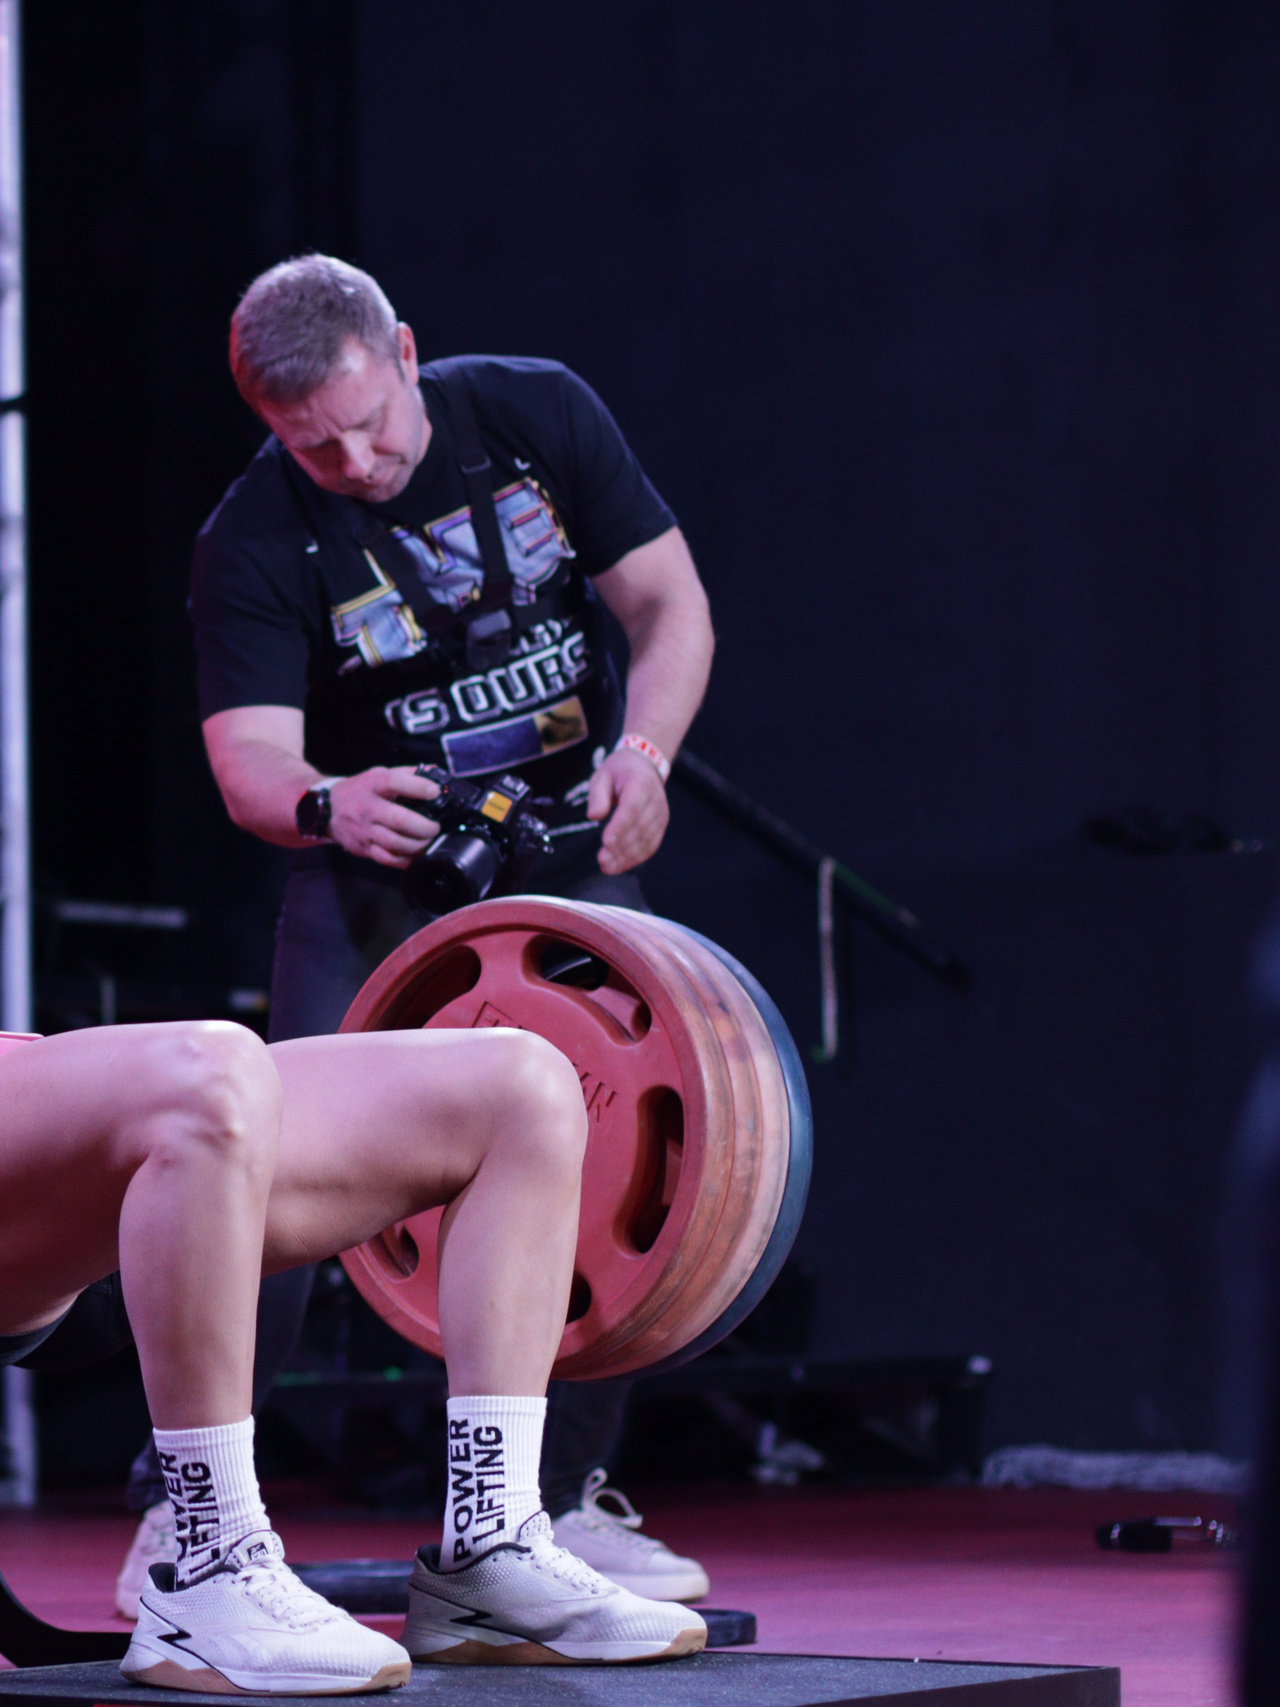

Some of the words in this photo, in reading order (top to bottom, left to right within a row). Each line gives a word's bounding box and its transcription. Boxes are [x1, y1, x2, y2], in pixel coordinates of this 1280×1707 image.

[158, 1451, 188, 1587] OWER
[181, 1461, 220, 1576] LIFTING
[449, 1418, 476, 1563] POWER
[472, 1425, 506, 1545] LIFTING
